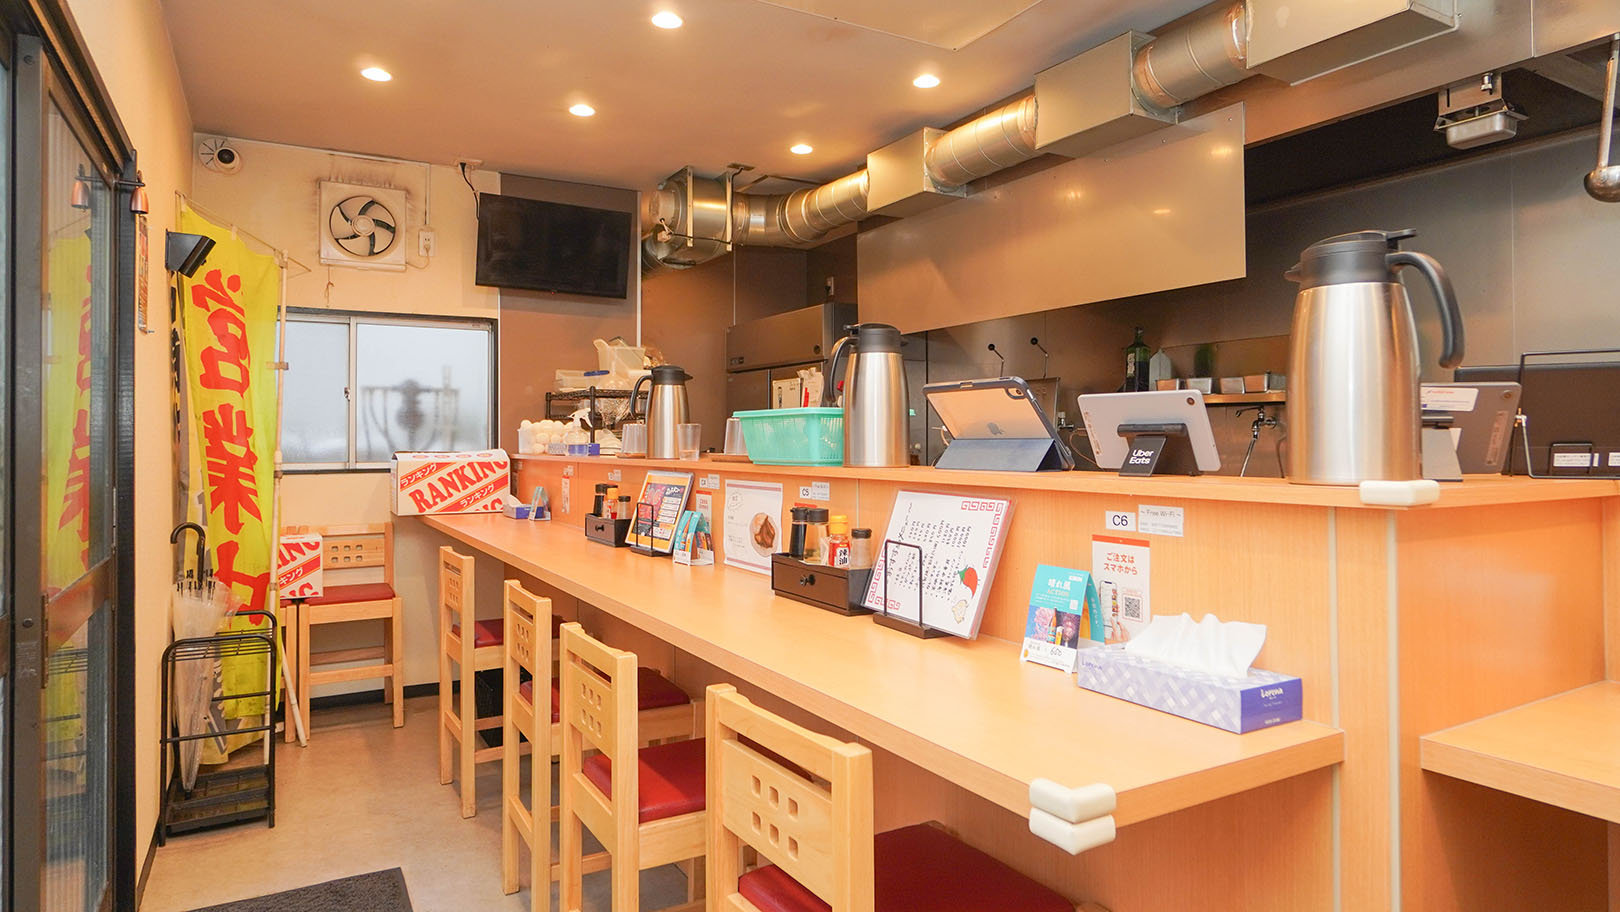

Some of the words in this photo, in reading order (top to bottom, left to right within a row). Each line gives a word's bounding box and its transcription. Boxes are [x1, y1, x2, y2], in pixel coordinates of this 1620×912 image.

[1132, 449, 1154, 458] Uber
[1129, 457, 1151, 465] Eats
[400, 463, 436, 486] ランキング
[459, 484, 494, 507] ランキング
[801, 488, 810, 496] C5
[1146, 509, 1159, 517] Free
[1112, 514, 1129, 527] C6
[839, 549, 848, 565] 辣油
[1106, 552, 1135, 563] ご注文は
[1103, 563, 1138, 575] スマホから
[279, 567, 303, 584] キング
